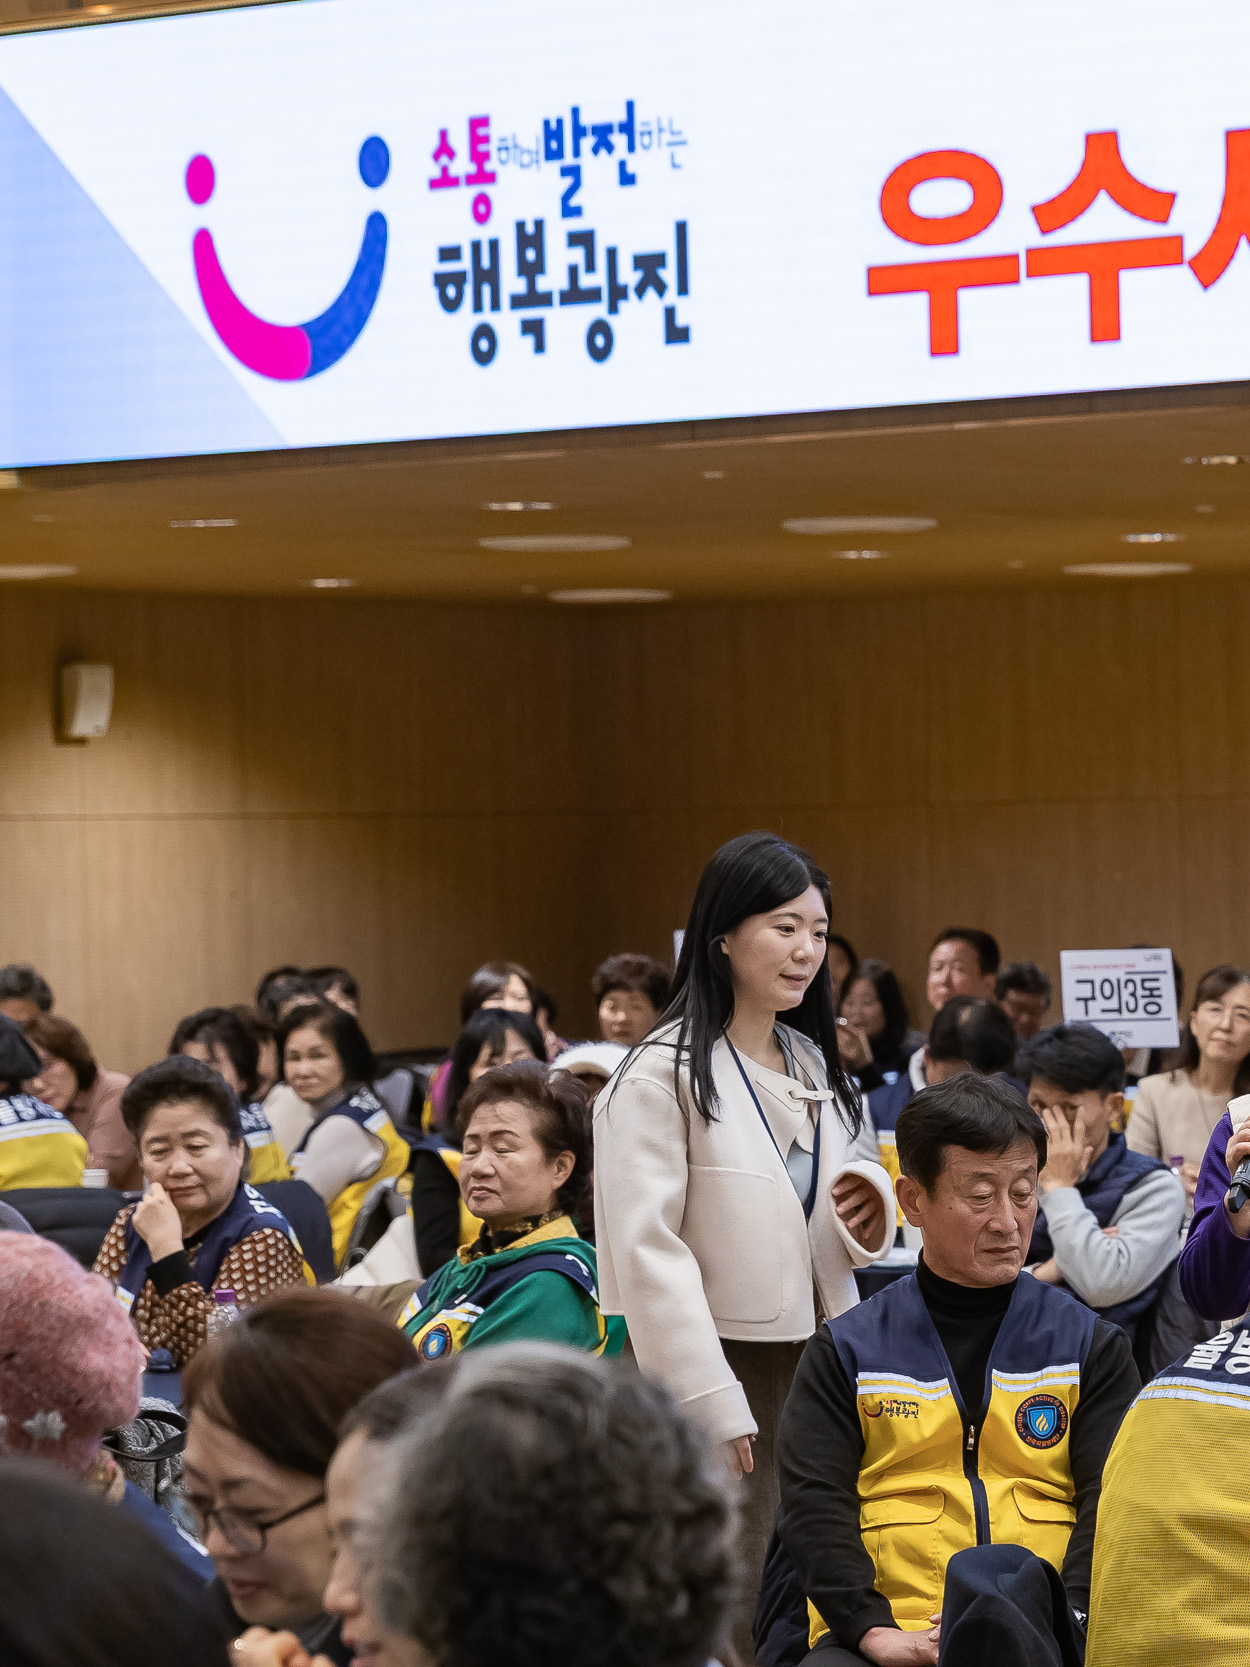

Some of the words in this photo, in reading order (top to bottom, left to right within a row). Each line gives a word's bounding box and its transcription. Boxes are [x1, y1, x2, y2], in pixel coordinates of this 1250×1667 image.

[428, 114, 541, 226] 소통하며
[542, 99, 689, 218] 발전하는
[433, 218, 690, 366] 행복광진
[1074, 977, 1163, 1016] 구의3동
